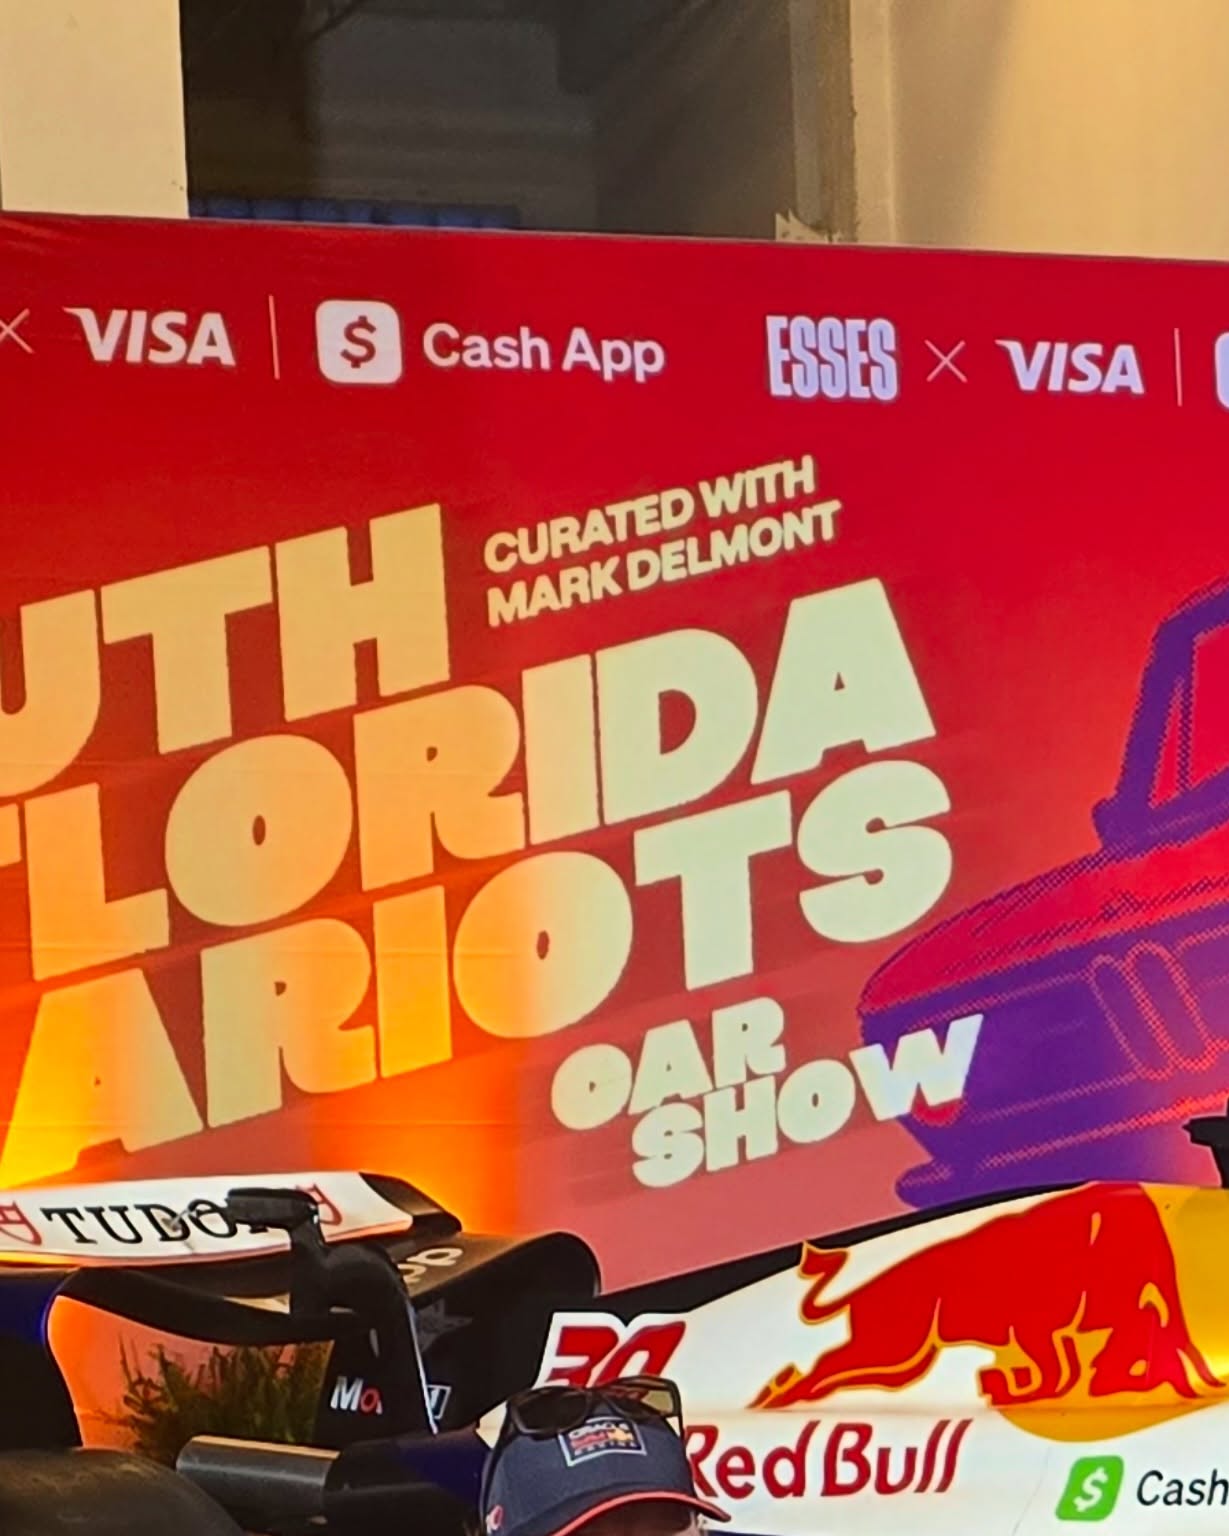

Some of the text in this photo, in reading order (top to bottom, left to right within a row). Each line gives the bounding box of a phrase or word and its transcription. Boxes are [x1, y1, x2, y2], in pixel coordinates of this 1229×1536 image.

[63, 306, 236, 367] VISA
[423, 323, 551, 371] Cash
[562, 326, 666, 382] App
[766, 314, 899, 401] ESSES
[995, 339, 1145, 396] VISA
[484, 455, 816, 572] CURATED WITH
[486, 500, 841, 627] MARK DELMONT
[0, 577, 937, 981] LORIDA
[0, 759, 954, 1190] ARIOTS
[632, 1014, 983, 1188] SHOW
[40, 1200, 268, 1245] TUDO
[685, 1420, 820, 1498] Red
[820, 1418, 973, 1497] Bull
[1136, 1468, 1229, 1507] Cash
